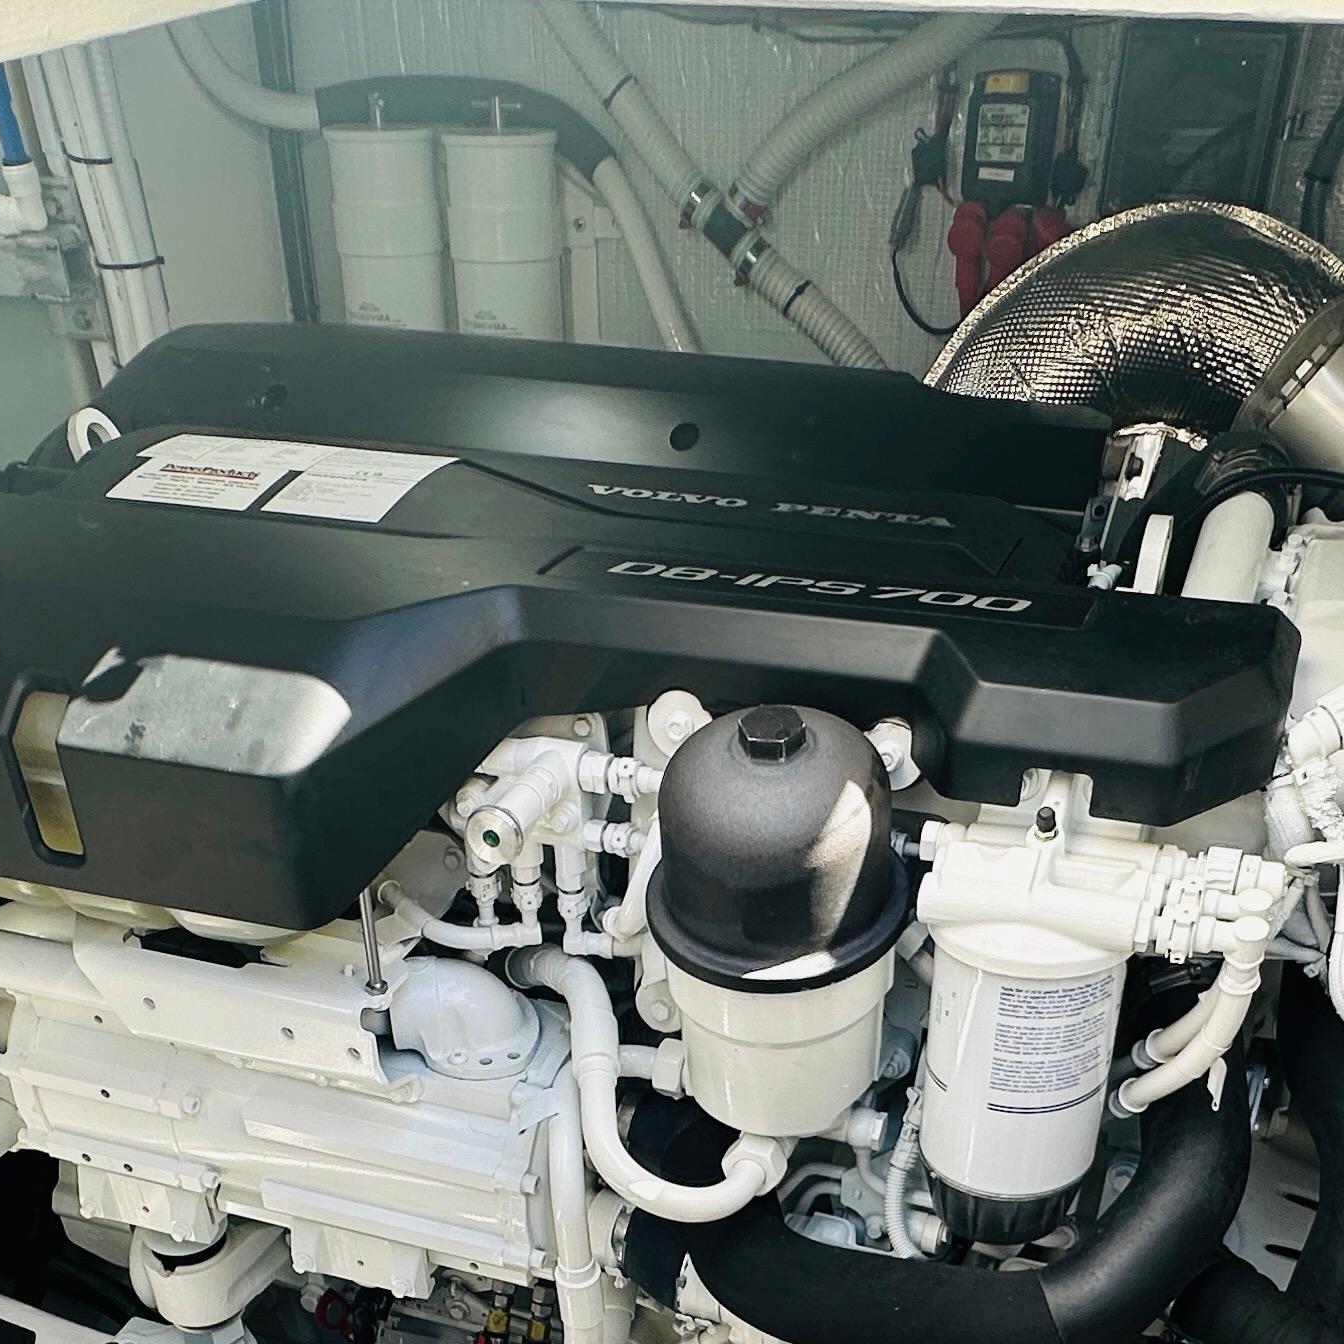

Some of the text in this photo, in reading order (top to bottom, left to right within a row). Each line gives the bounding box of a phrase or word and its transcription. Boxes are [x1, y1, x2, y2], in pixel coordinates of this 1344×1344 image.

[587, 484, 956, 528] VOLVO PENTA
[606, 560, 1033, 612] D8-IPS 700
